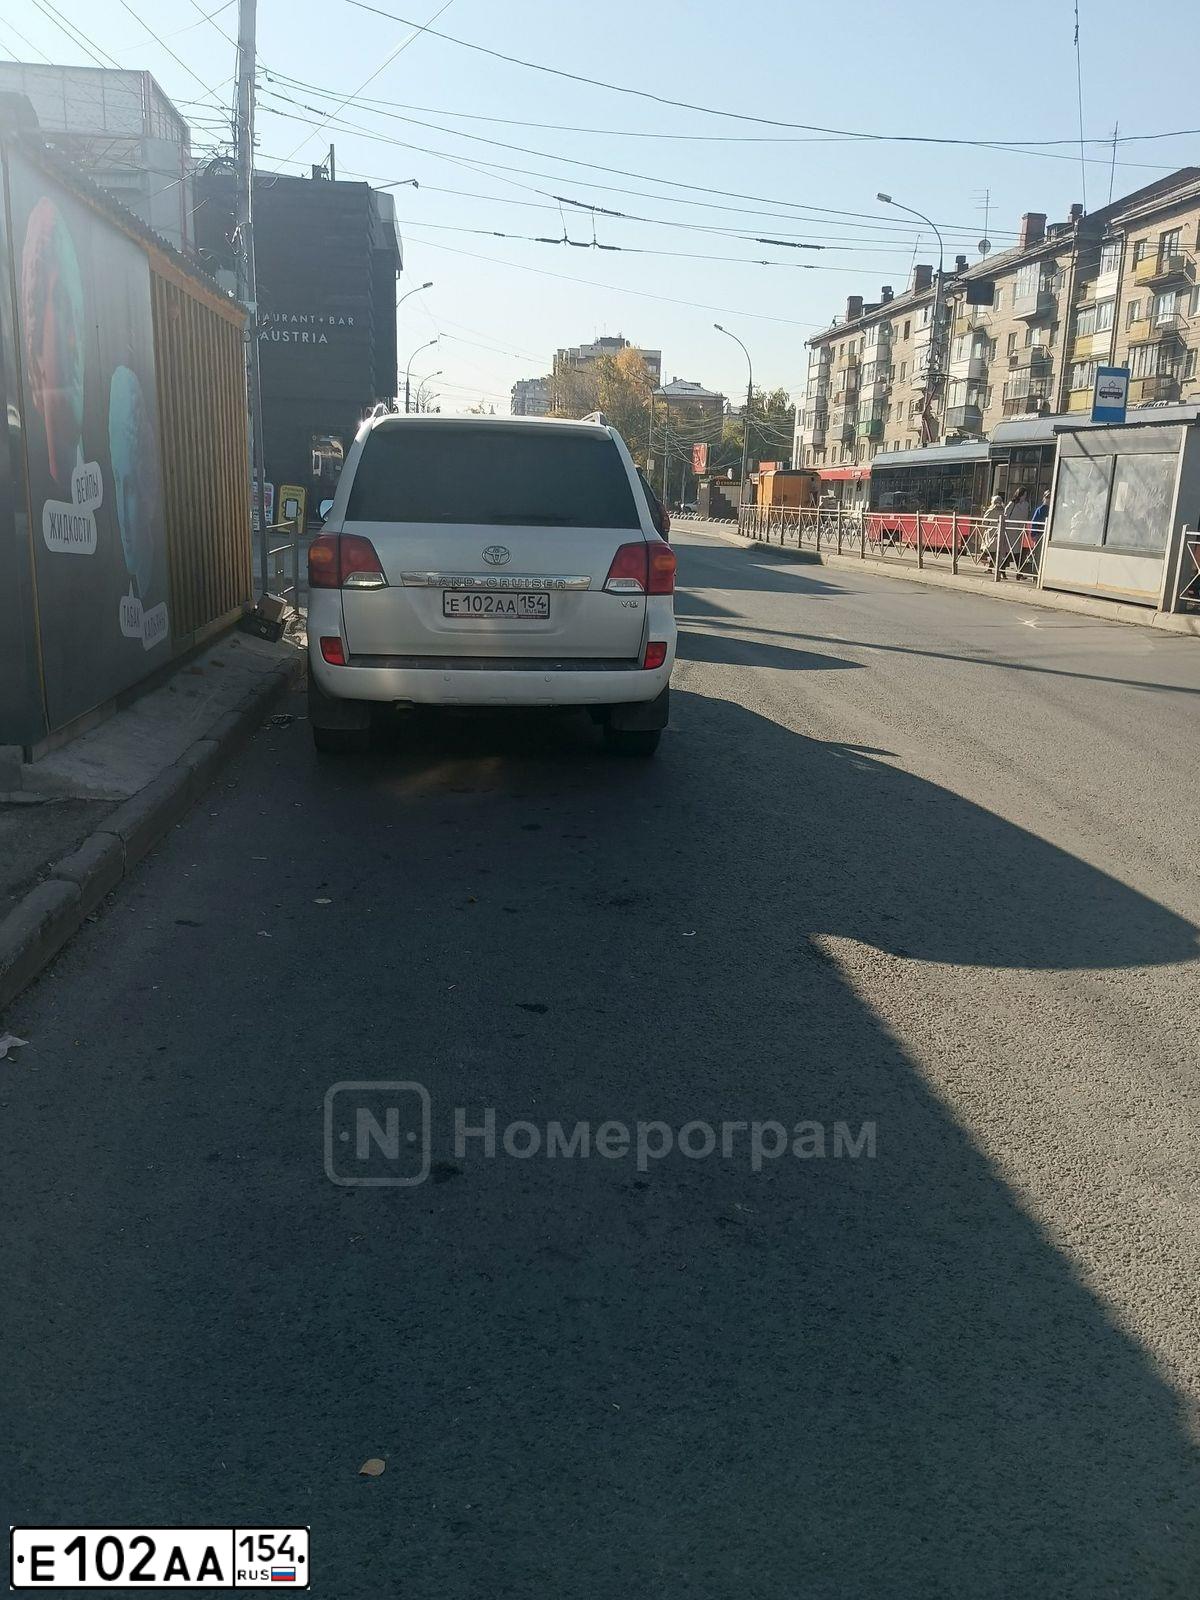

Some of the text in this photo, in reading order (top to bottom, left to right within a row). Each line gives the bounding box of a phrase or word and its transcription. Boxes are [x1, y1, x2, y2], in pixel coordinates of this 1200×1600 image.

[258, 313, 354, 326] AURANT BAR
[260, 330, 328, 344] AUSTRIA
[76, 470, 99, 504] ВЕЙПЫ
[48, 511, 92, 544] ЖИДКОСТИ
[427, 577, 567, 589] LAND CRUISER
[520, 595, 545, 609] 154
[123, 604, 141, 628] ТАБАК
